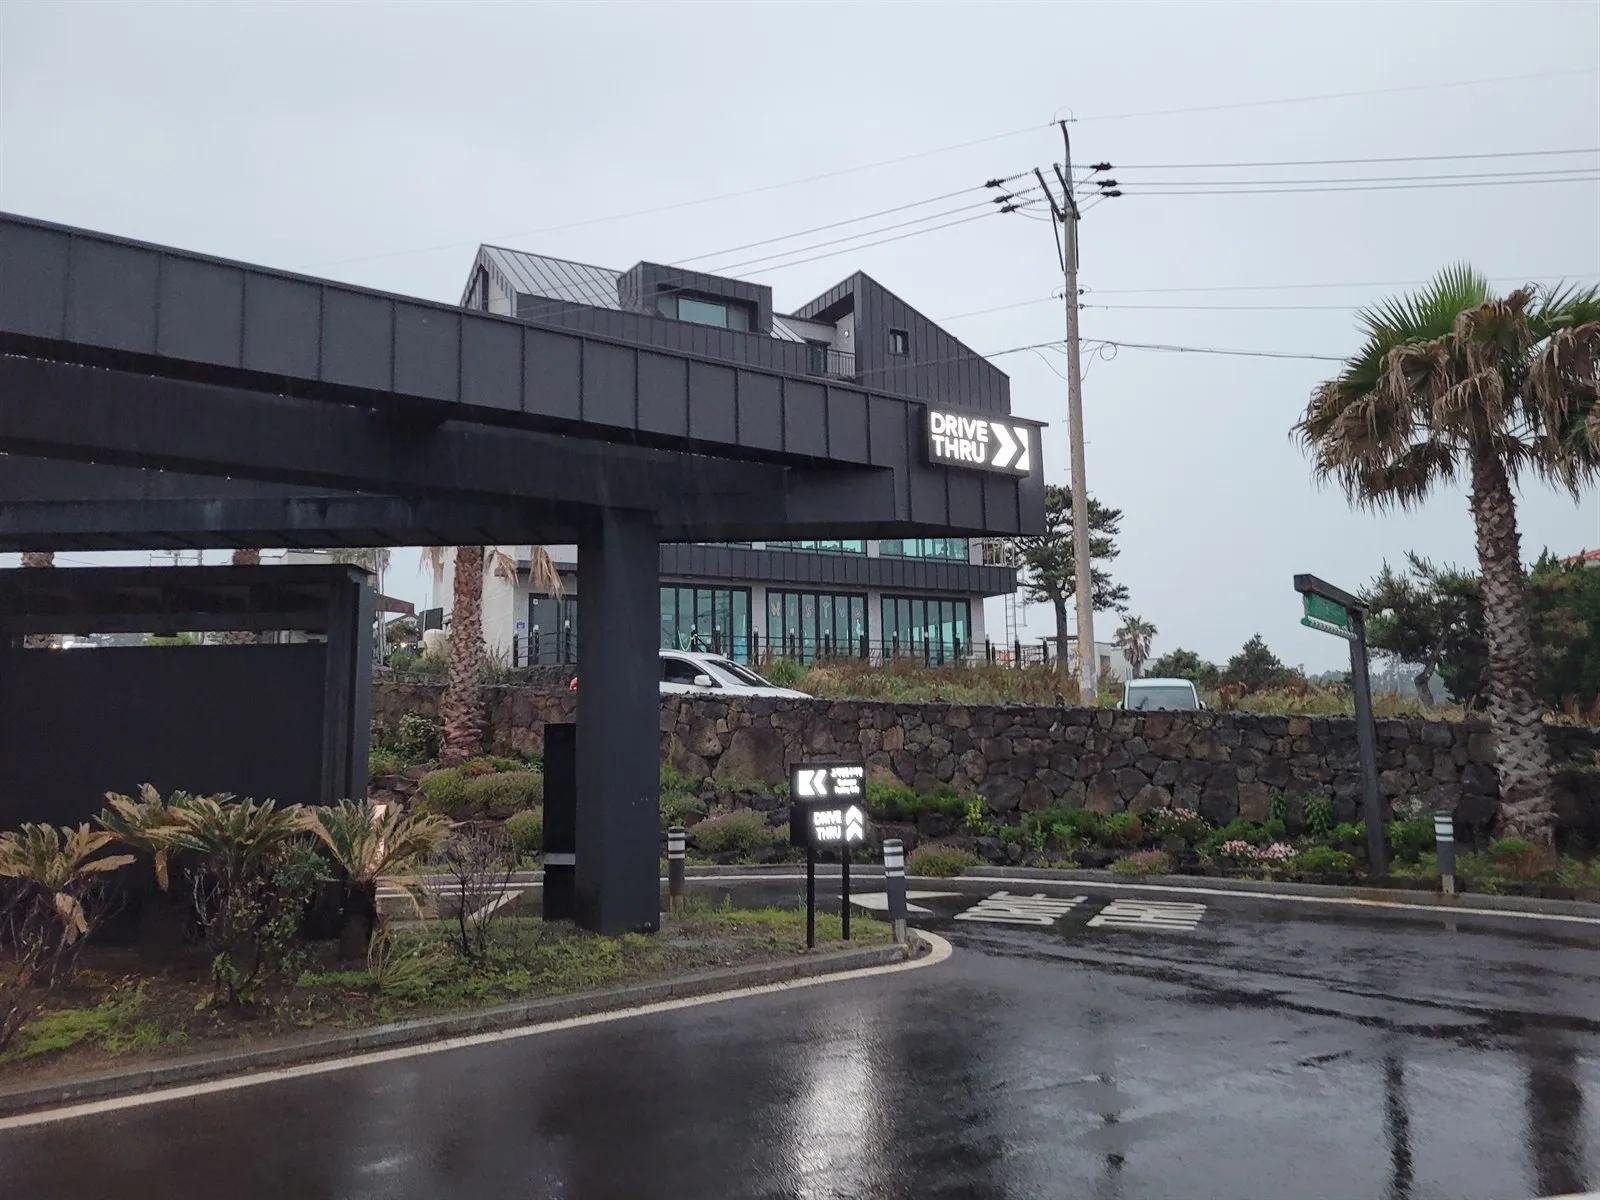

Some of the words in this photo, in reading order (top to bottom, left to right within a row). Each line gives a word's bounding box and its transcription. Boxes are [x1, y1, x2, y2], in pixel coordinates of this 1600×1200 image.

[930, 411, 988, 443] DRIVE
[932, 434, 985, 464] THRU
[814, 810, 842, 826] DRIVE
[815, 826, 842, 840] THRU
